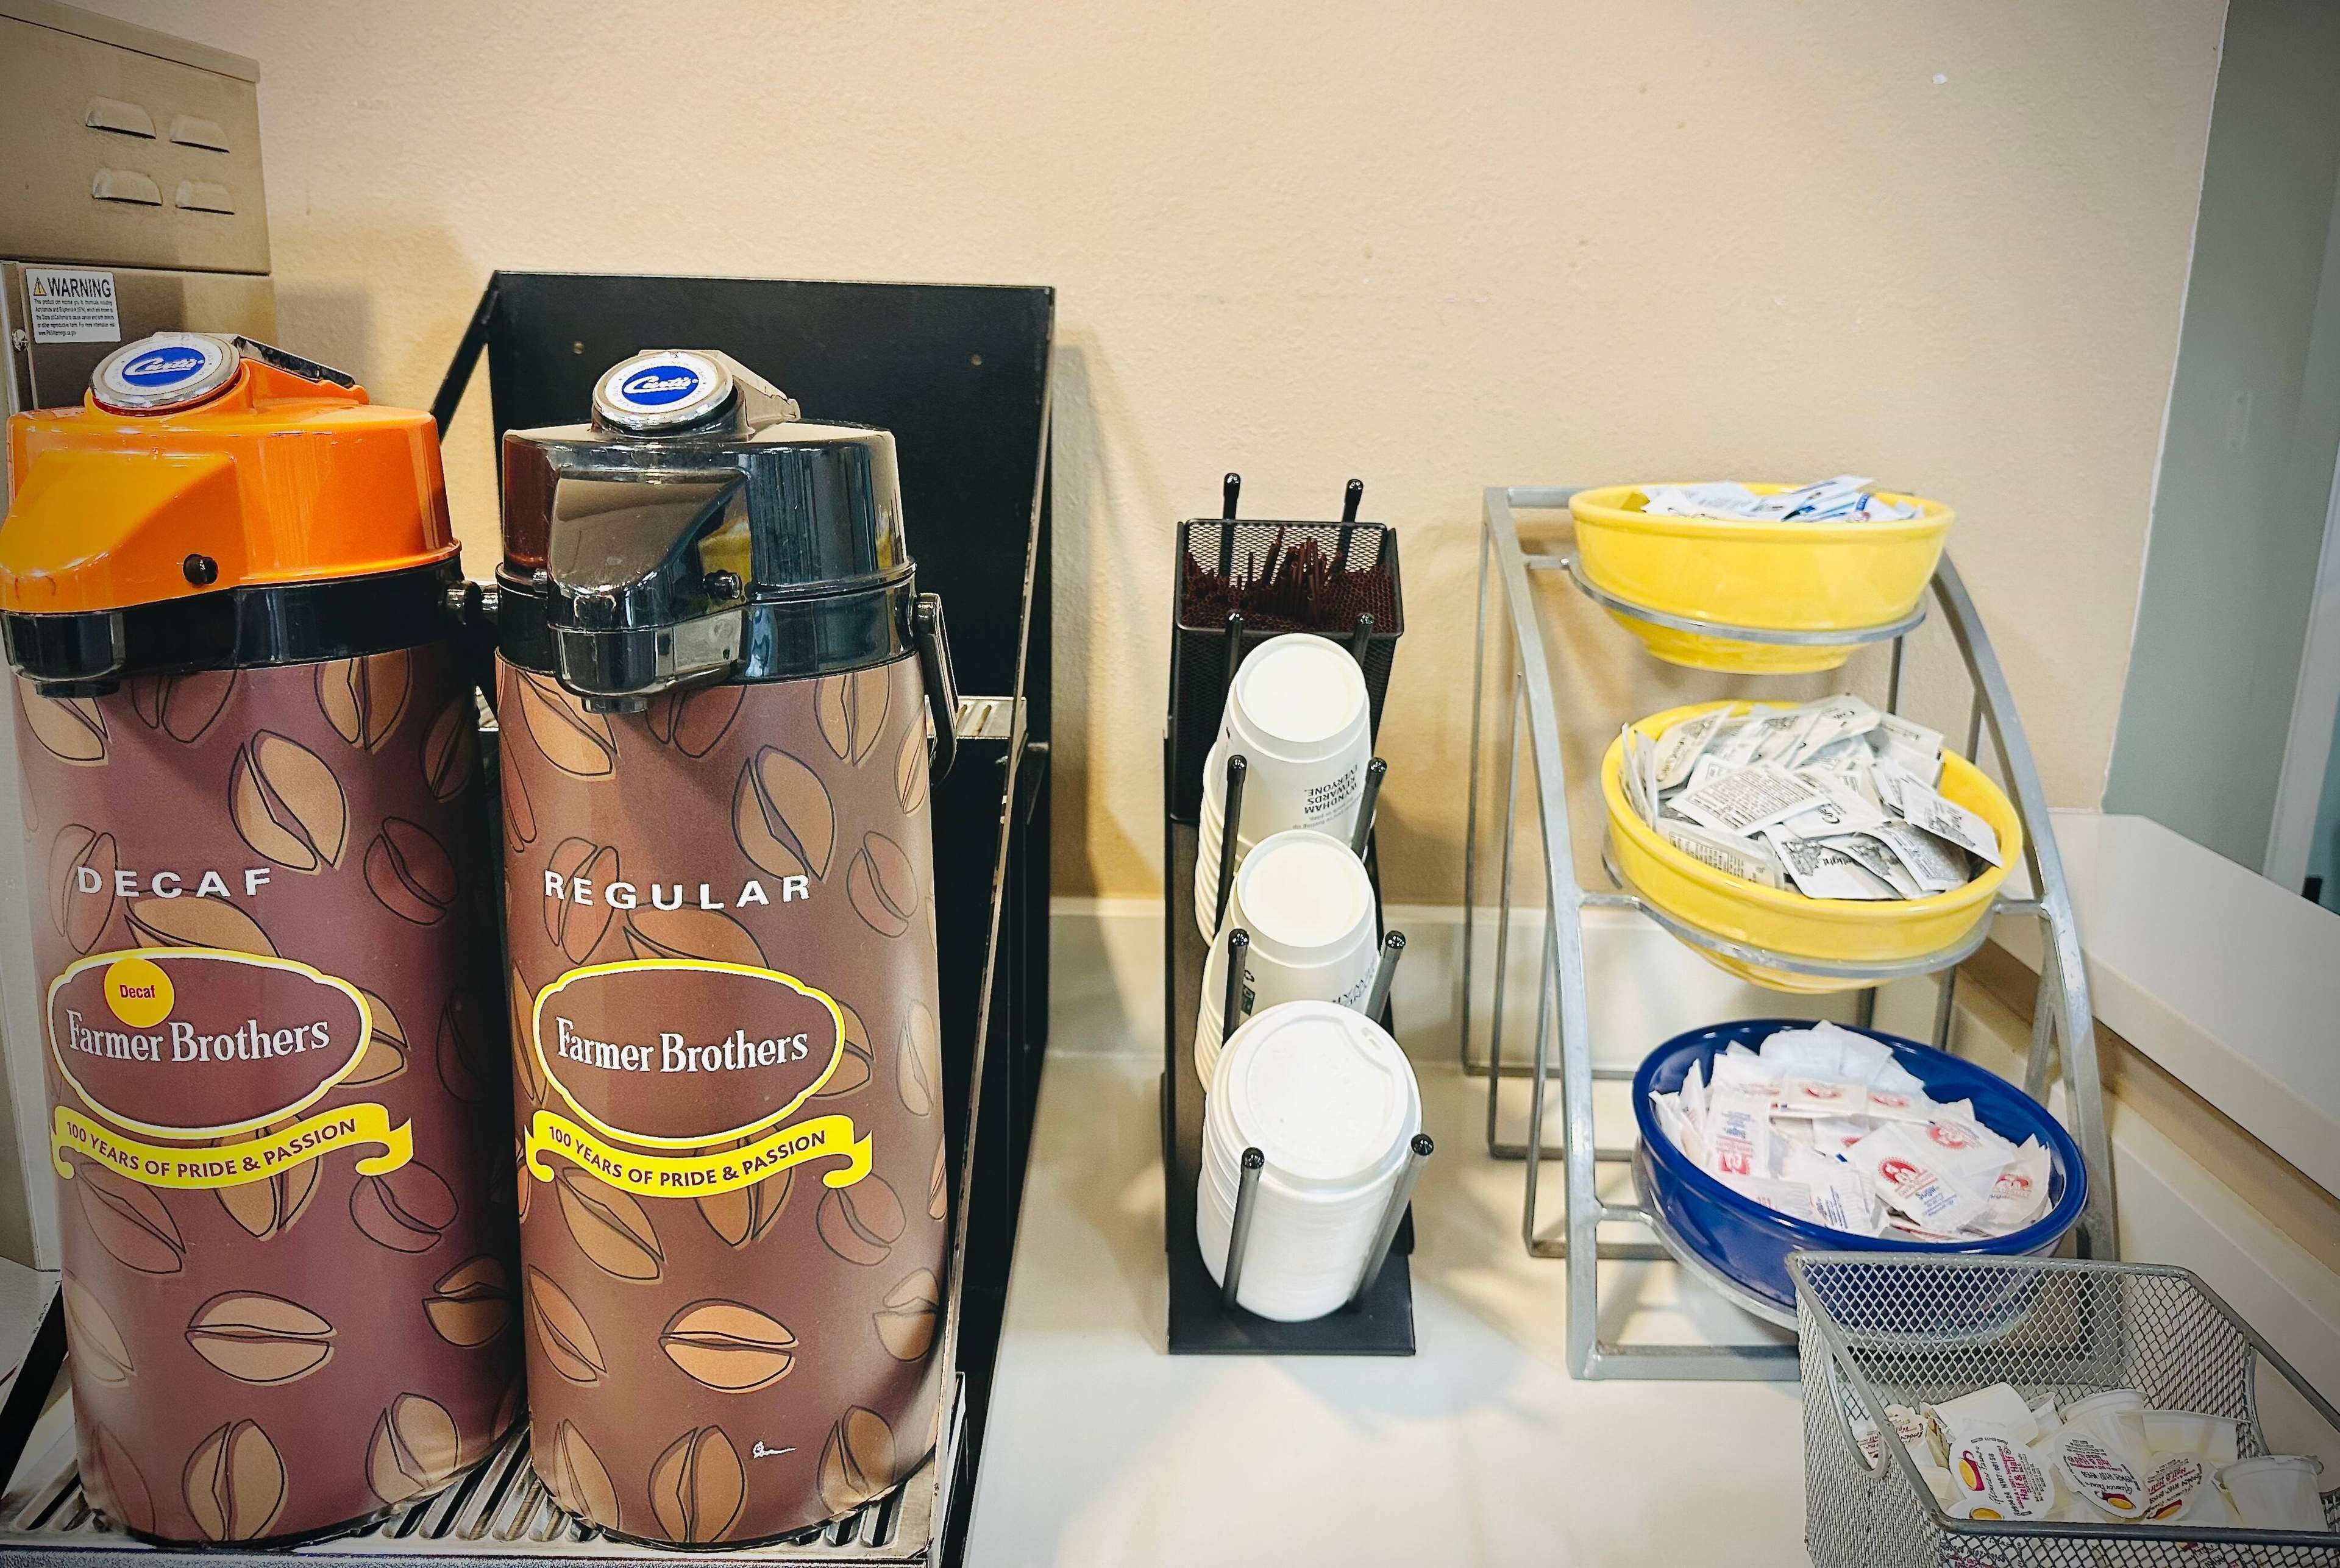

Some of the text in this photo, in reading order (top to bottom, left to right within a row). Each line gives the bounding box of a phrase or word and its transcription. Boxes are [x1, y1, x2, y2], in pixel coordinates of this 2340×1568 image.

[48, 277, 111, 297] WARNING
[1304, 764, 1357, 796] EVERYONE.
[1307, 775, 1354, 805] REWARDS
[1304, 782, 1357, 814] WYNDHAM
[77, 867, 271, 898] DECAF
[544, 870, 810, 910] REGULAR
[119, 984, 155, 999] Decaf
[66, 1009, 330, 1063] Farmer Brothers
[556, 1016, 808, 1073] Farmer Brothers
[67, 1118, 355, 1178] 100 YEARS OF PRIDE & PASSION
[549, 1126, 825, 1187] 100 YEARS OF PRIDE & PASSION
[2005, 1455, 2019, 1472] Half
[2015, 1483, 2030, 1500] Half
